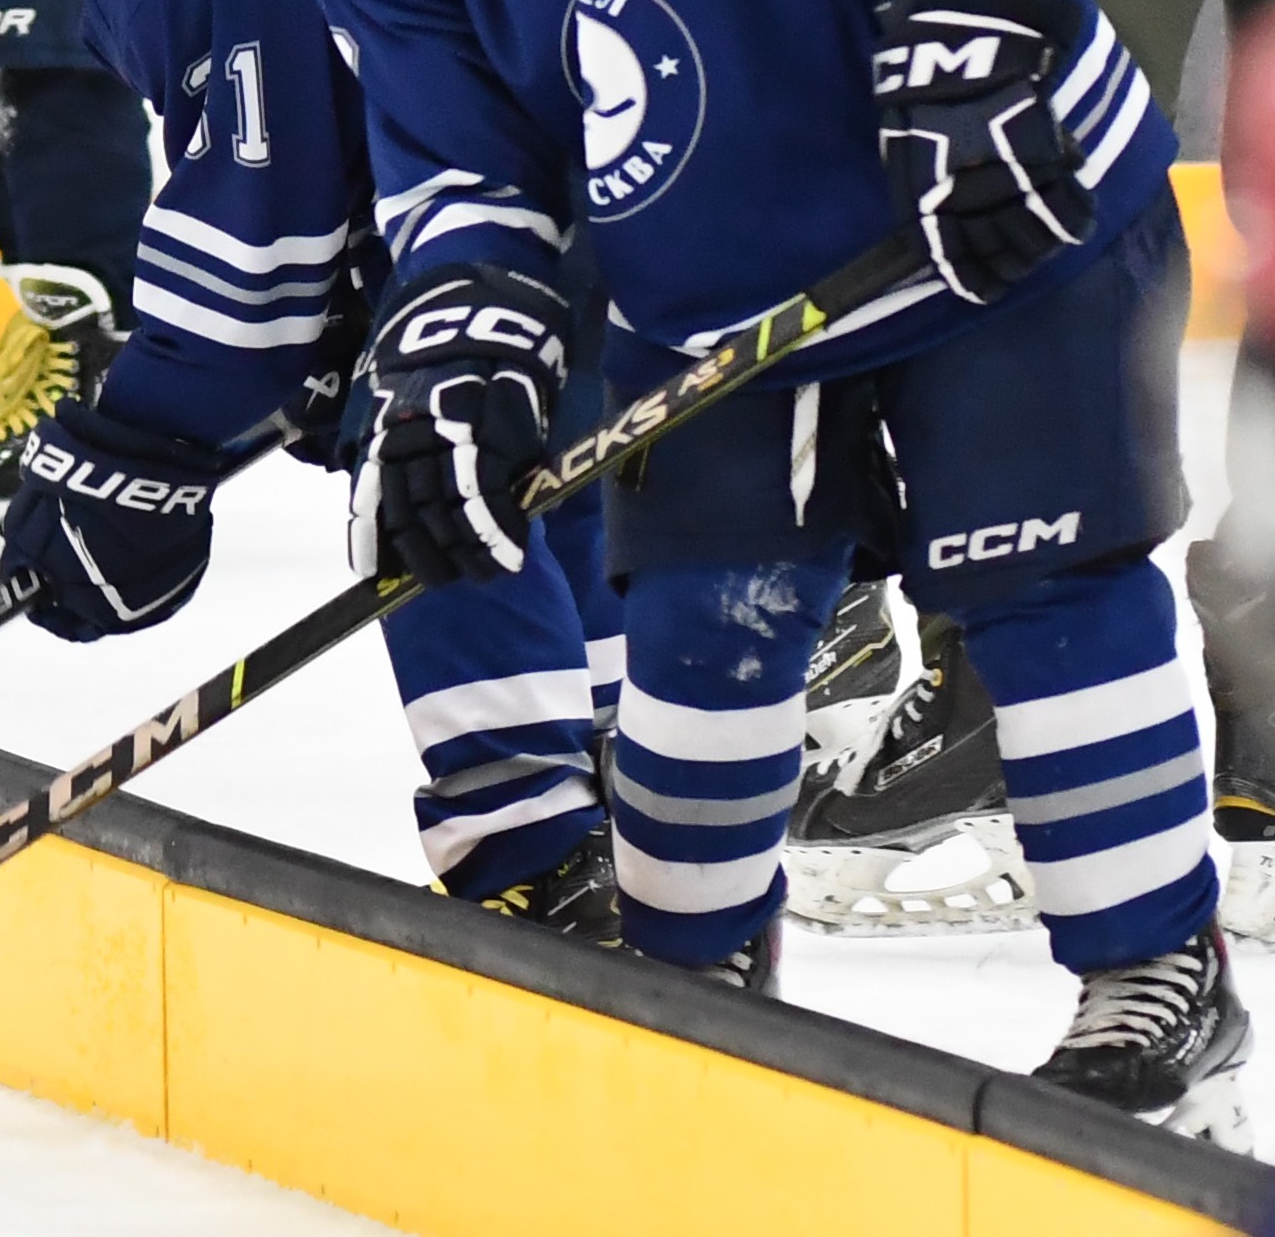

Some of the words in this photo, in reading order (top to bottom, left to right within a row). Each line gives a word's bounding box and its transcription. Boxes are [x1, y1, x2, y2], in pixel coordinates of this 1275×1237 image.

[873, 36, 1002, 94] CM
[20, 430, 207, 515] BAUER
[519, 389, 668, 510] ACKS
[928, 511, 1081, 570] CCM
